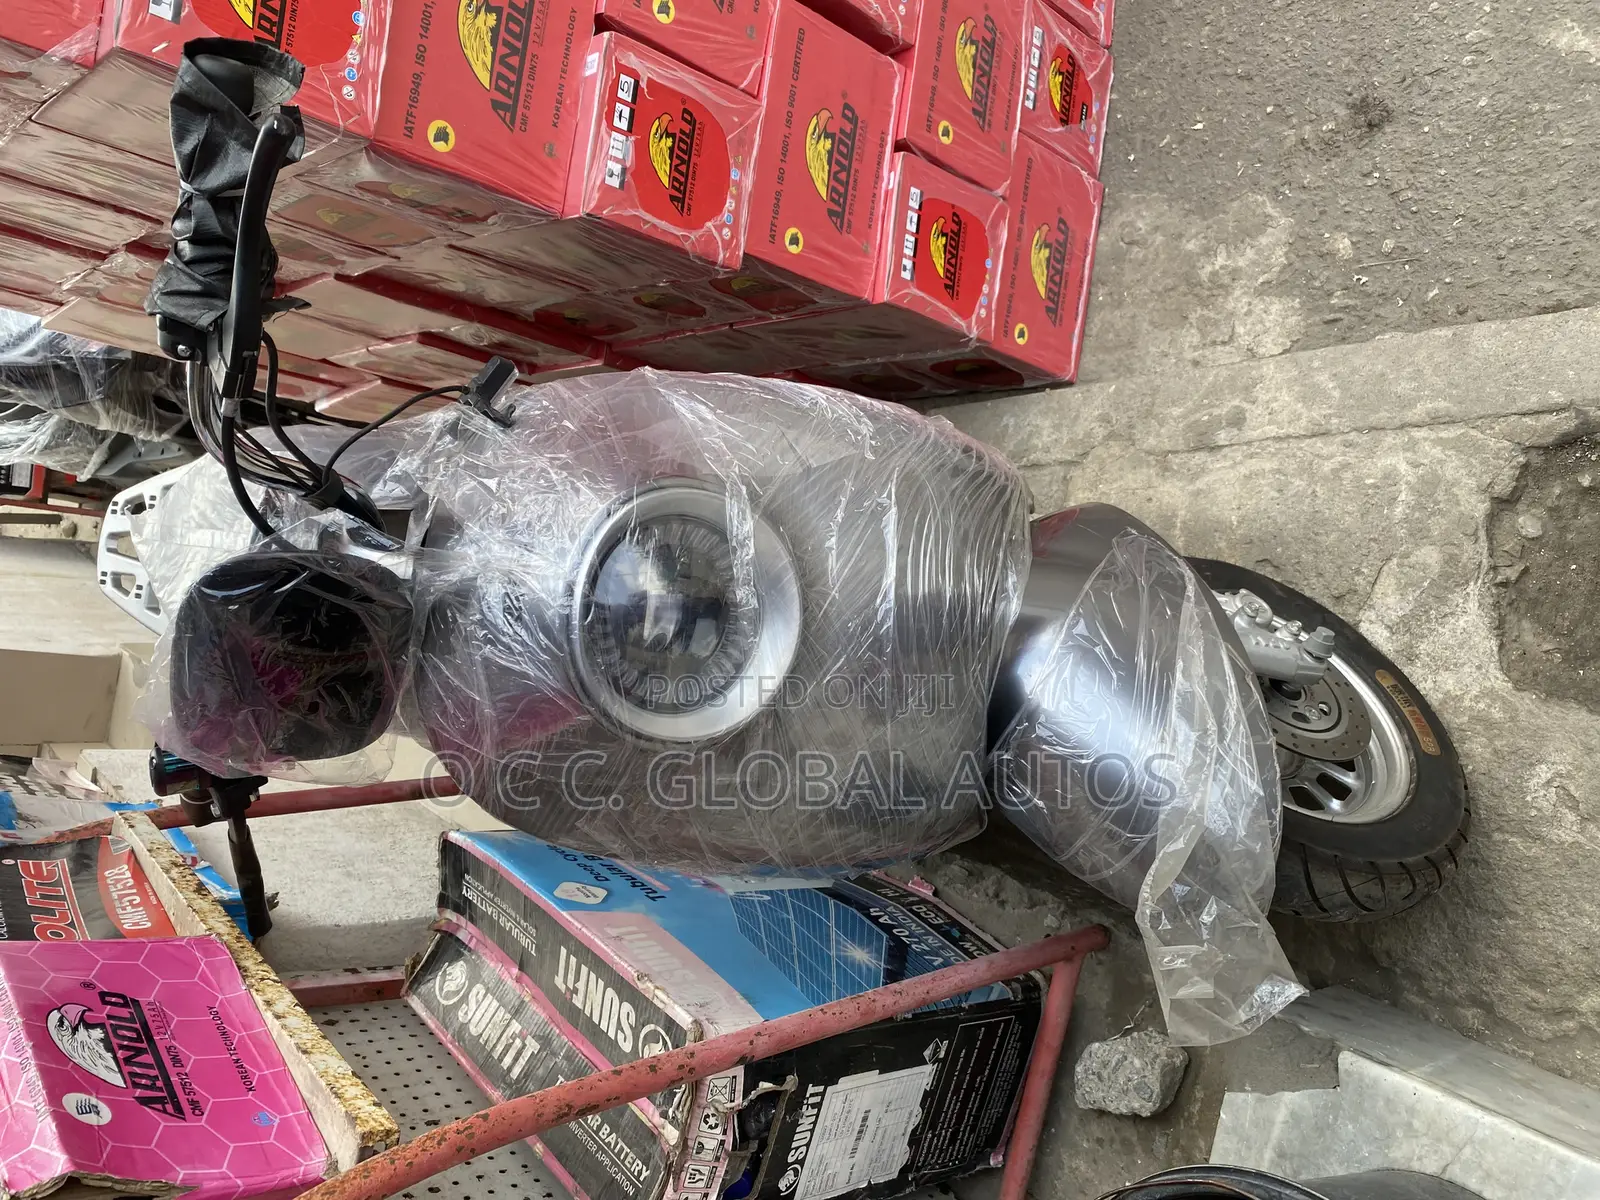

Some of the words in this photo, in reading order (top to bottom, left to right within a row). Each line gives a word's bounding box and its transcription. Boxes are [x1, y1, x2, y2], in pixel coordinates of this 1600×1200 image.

[419, 0, 437, 40] 14001,
[939, 16, 947, 32] ISO
[285, 24, 296, 47] 57512
[935, 35, 945, 61] 14001,
[415, 43, 428, 67] ISO
[528, 53, 539, 80] DIN75
[551, 83, 566, 128] KOREAN
[560, 7, 578, 80] TECHNOLOGY
[792, 28, 806, 81] CERTIFIED
[932, 65, 940, 81] ISO
[972, 14, 997, 133] ARNOLD
[523, 83, 534, 110] 57512
[788, 84, 798, 108] 9001
[1059, 54, 1076, 126] ARNOLD
[403, 71, 425, 139] IATF16949,
[925, 85, 937, 133] IATF16949,
[519, 113, 531, 133] CMF
[784, 110, 793, 129] ISO
[780, 132, 792, 164] 14001,
[668, 108, 697, 216] ARNOLD
[691, 163, 699, 183] DIN75
[827, 102, 858, 235] ARNOLD
[777, 167, 785, 185] ISO
[852, 168, 860, 191] DIN75
[868, 193, 877, 229] KOREAN
[873, 130, 886, 190] TECHNOLOGY
[1022, 157, 1034, 202] CERTIFIED
[688, 182, 696, 202] 57512
[769, 188, 784, 244] IATF16949,
[849, 195, 857, 216] 57512
[1019, 203, 1027, 223] 9001
[845, 219, 853, 235] CMF
[1016, 223, 1024, 243] ISO
[944, 211, 962, 300] ARNOLD
[1009, 273, 1017, 290] ISO
[1045, 217, 1070, 328] ARNOLD
[576, 863, 611, 882] Deep
[600, 863, 667, 902] Tubular
[104, 864, 152, 930] CMF57528
[464, 873, 494, 899] APPLICATION
[17, 860, 80, 941] OLITE
[462, 886, 498, 920] BATTERY
[869, 908, 898, 925] Ah
[886, 906, 925, 934] INDIA
[911, 905, 944, 924] ECO
[499, 917, 536, 957] TUBULAR
[520, 919, 536, 937] SOLAR
[893, 928, 931, 951] 270
[923, 935, 942, 947] IN
[1, 1000, 13, 1019] 9001
[7, 1018, 18, 1034] ISO
[207, 1005, 239, 1057] TECHNOLOGY
[20, 1056, 31, 1074] ISO
[98, 991, 186, 1122] ARNOLD
[165, 1045, 184, 1068] DIN75
[176, 1072, 197, 1097] 57512
[233, 1057, 256, 1093] KOREAN
[187, 1100, 204, 1117] CMF
[568, 1121, 598, 1155] INVERTER
[596, 1151, 636, 1196] APPLICATION
[599, 1123, 651, 1182] BATTERY
